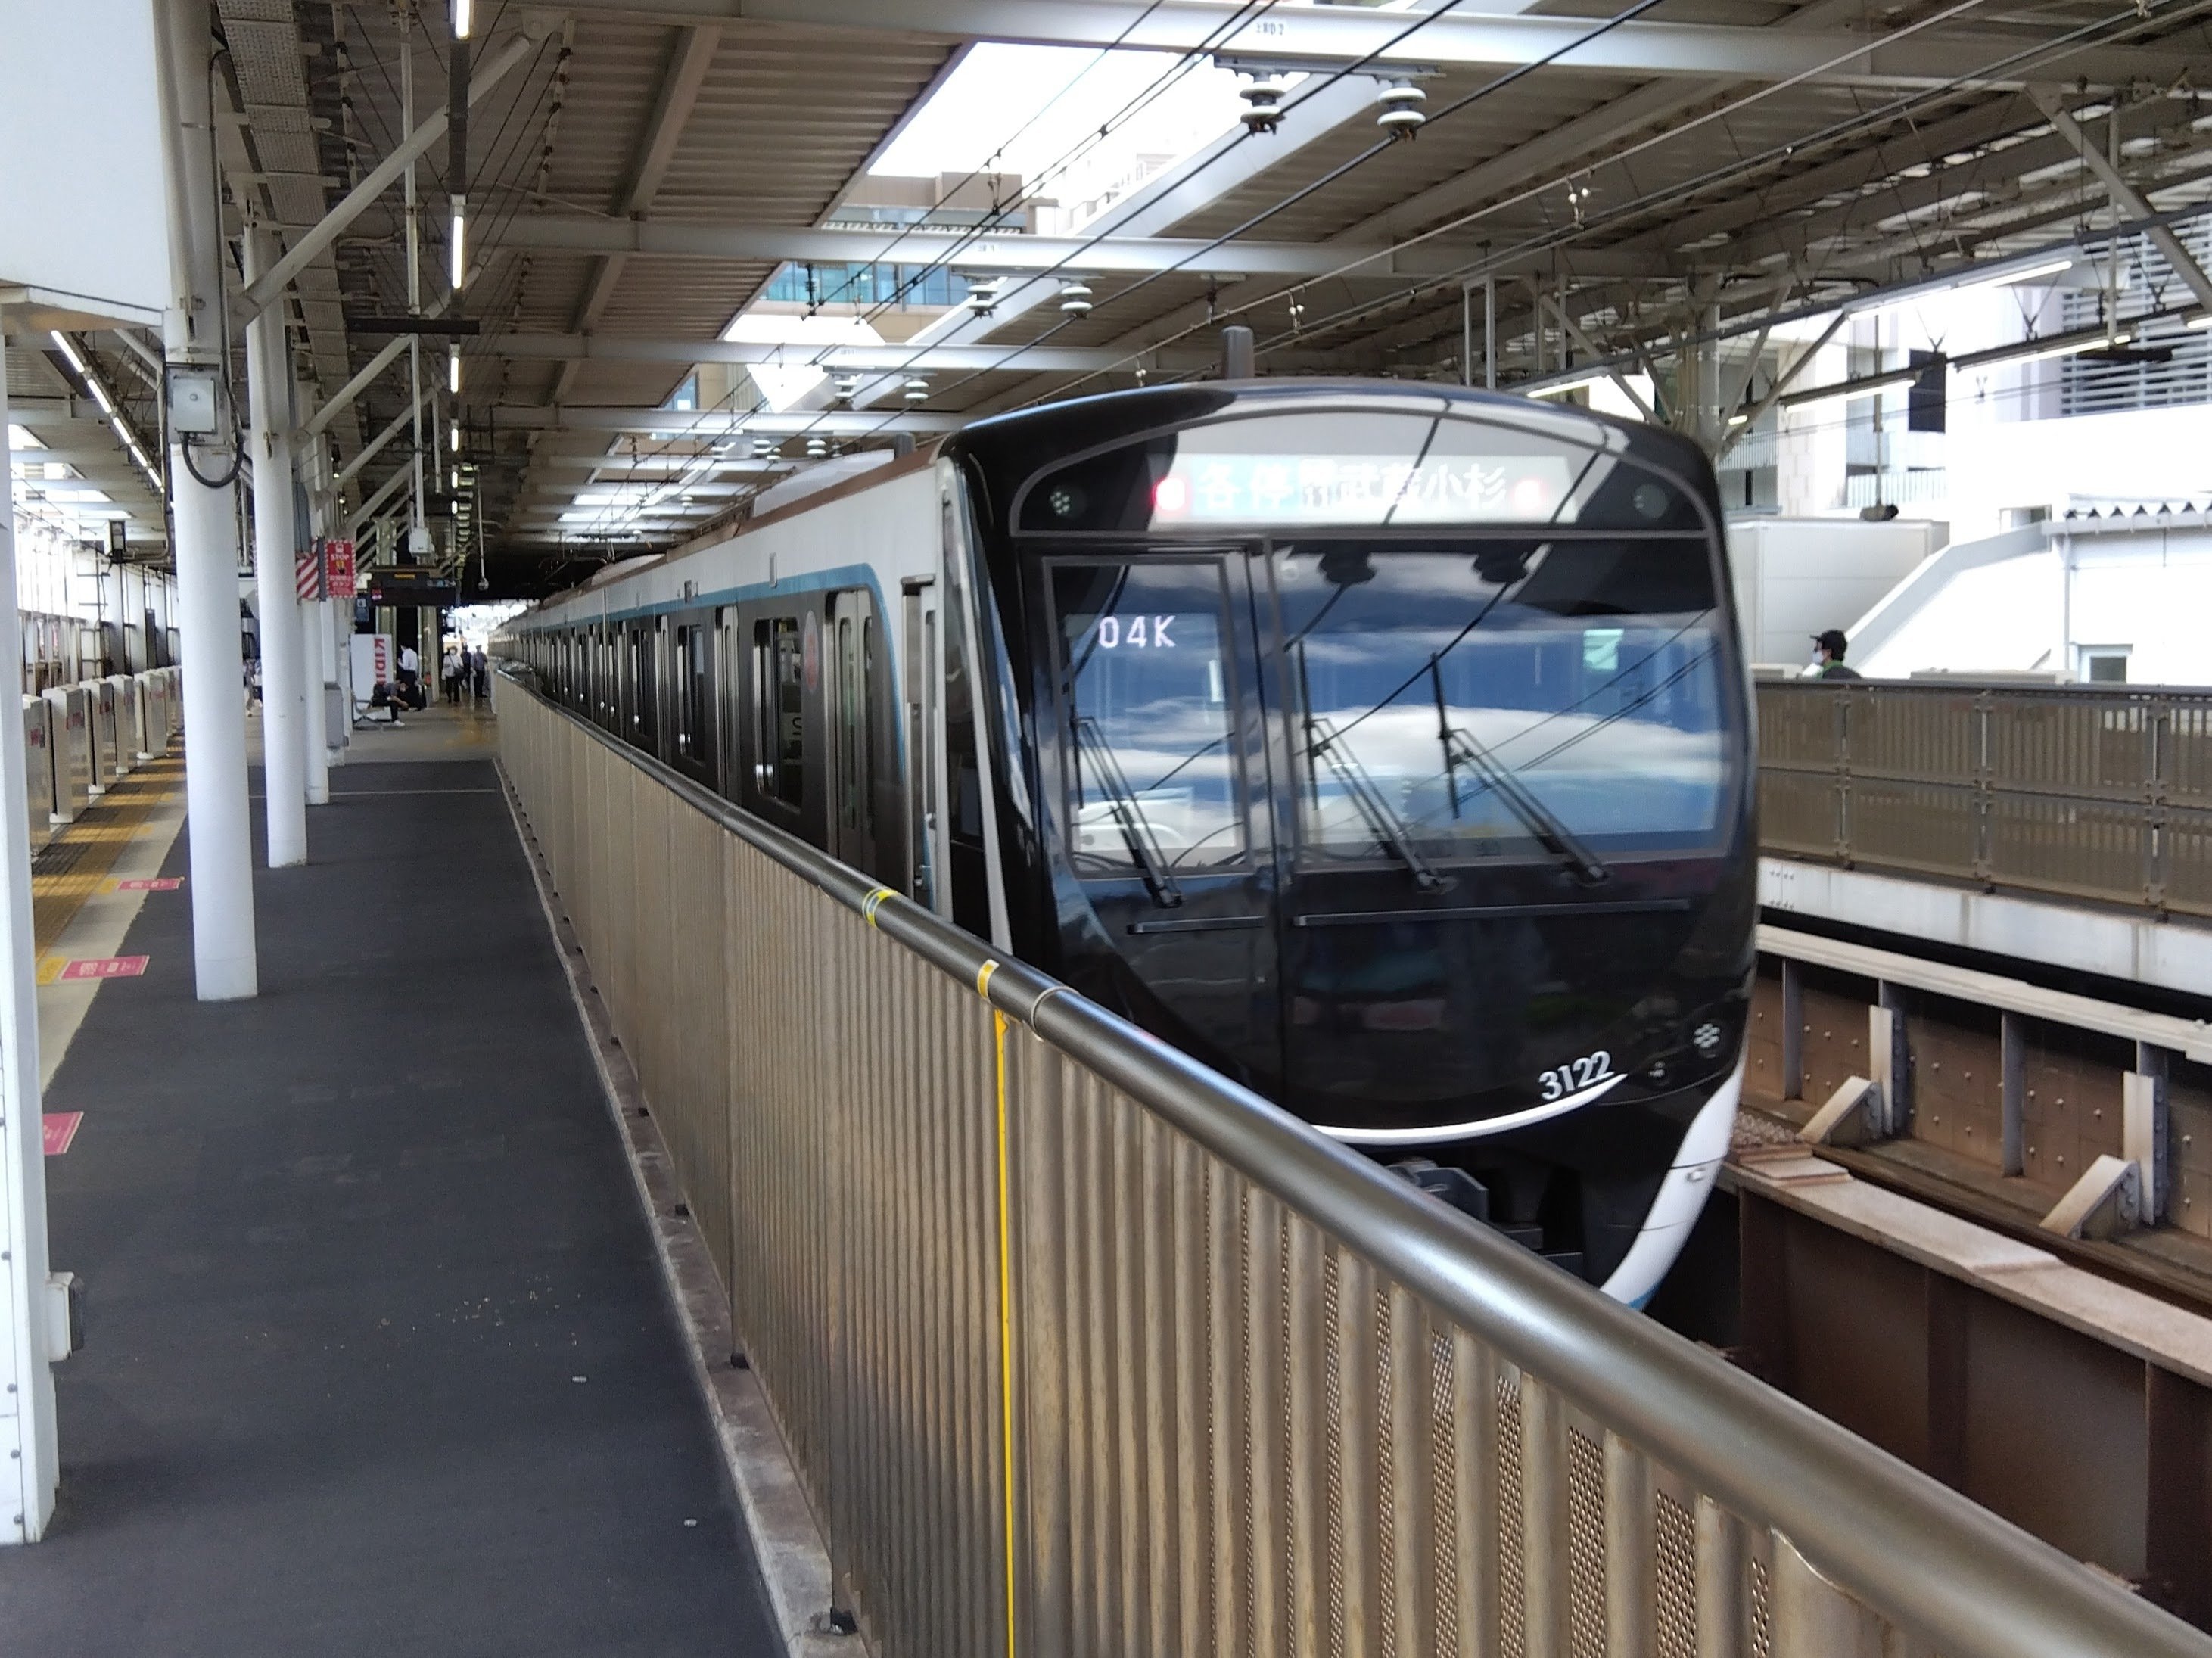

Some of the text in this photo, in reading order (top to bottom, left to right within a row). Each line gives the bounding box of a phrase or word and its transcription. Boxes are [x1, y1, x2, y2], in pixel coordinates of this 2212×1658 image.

[1198, 461, 1295, 509] 各停
[1338, 462, 1507, 509] 武蔵小杉
[1098, 615, 1177, 649] 04K
[1538, 1050, 1615, 1100] 3122
